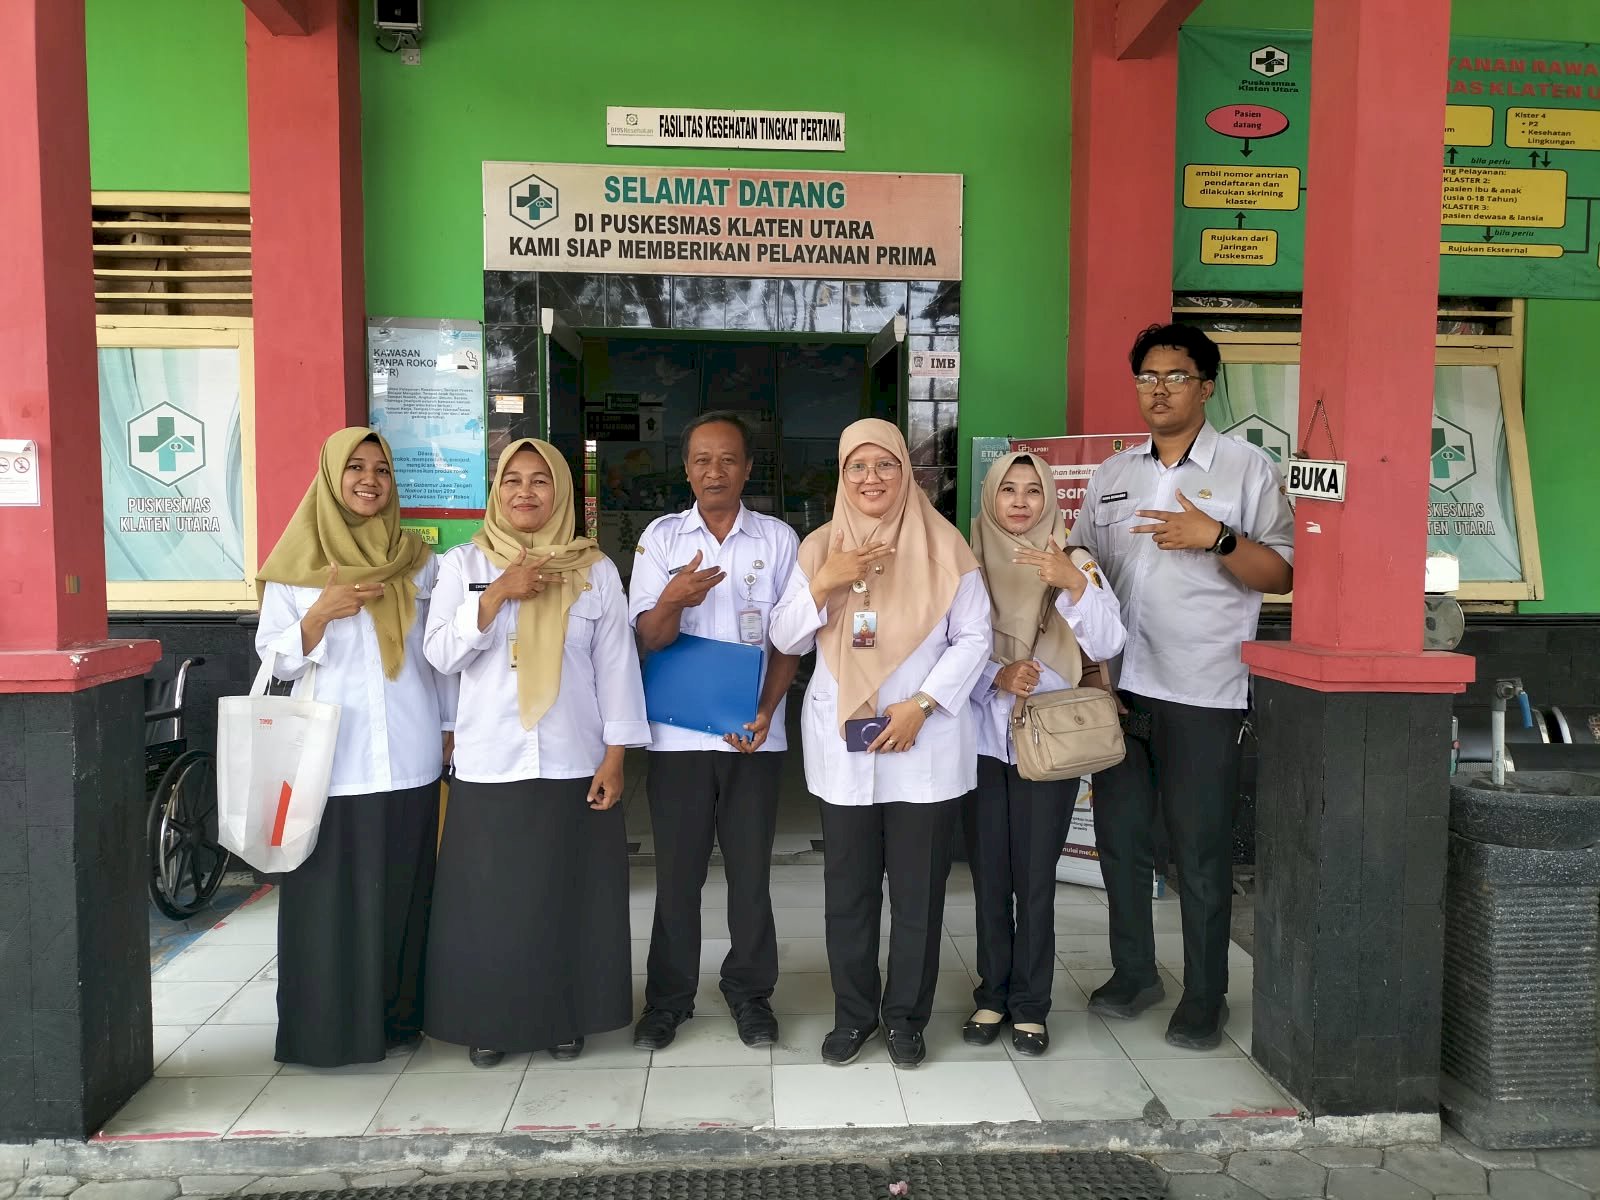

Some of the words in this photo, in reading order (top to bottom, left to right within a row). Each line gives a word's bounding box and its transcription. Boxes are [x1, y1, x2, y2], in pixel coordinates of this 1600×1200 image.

[1241, 79, 1296, 87] Puskesmas
[1490, 81, 1582, 99] KLATEN
[1234, 109, 1261, 118] Pasien
[659, 114, 703, 138] FASILITAS
[705, 116, 757, 140] KESEHATAN
[760, 117, 798, 141] TINGKAT
[801, 118, 841, 142] PERTAMA
[1233, 121, 1262, 131] datang
[1527, 129, 1571, 137] Kesehatan
[1527, 138, 1575, 146] Lingkungan
[1255, 171, 1289, 179] antrian
[1458, 168, 1507, 176] Pelayanan:
[1204, 180, 1260, 188] pendaftaran
[1443, 176, 1480, 184] KLASTER
[604, 175, 730, 206] SELAMAT
[739, 179, 845, 209] DATANG
[1199, 188, 1245, 196] dilakukan
[1246, 189, 1284, 198] skrining
[1443, 186, 1472, 194] pasien
[1486, 196, 1518, 204] Tahun)
[575, 213, 594, 232] DI
[601, 214, 721, 236] PUSKESMAS
[727, 217, 803, 238] KLATEN
[811, 219, 874, 240] UTARA
[1210, 234, 1248, 243] Rujukan
[509, 237, 560, 257] KAMI
[567, 238, 612, 258] SIAP
[619, 239, 750, 262] MEMBERIKAN
[757, 243, 869, 265] PELAYANAN
[877, 246, 936, 266] PRIMA
[1219, 243, 1258, 252] Jaringan
[1448, 245, 1484, 254] Rujukan
[1486, 246, 1528, 254] Eksternal
[1213, 252, 1264, 260] Puskesmas
[373, 349, 421, 358] KAWASAN
[374, 358, 404, 367] TANPA
[930, 358, 956, 369] IMB
[981, 450, 1004, 458] ETIKA
[1069, 468, 1091, 476] terkait
[1290, 465, 1339, 494] BUKA
[128, 497, 211, 514] PUSKESMAS
[119, 516, 171, 532] KLATEN
[175, 516, 221, 532] UTARA
[1454, 521, 1495, 536] UTARA
